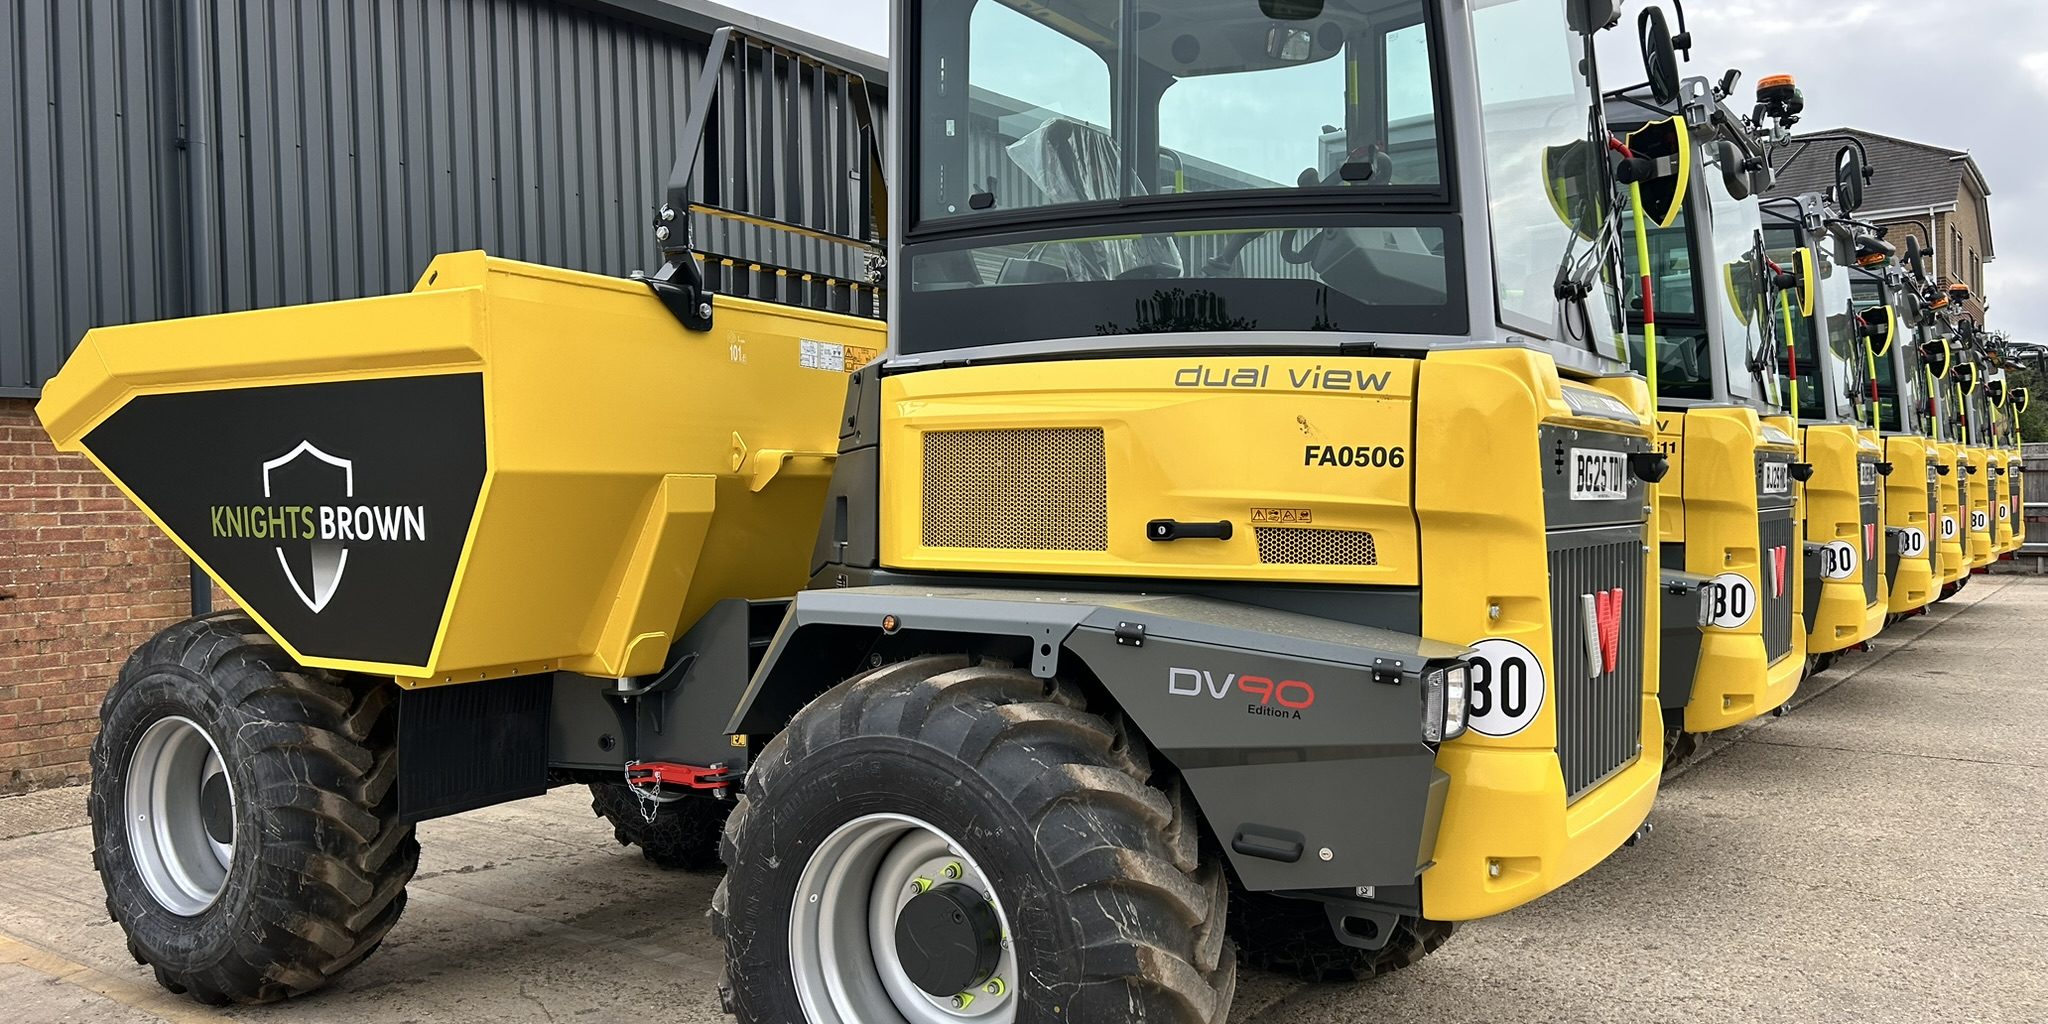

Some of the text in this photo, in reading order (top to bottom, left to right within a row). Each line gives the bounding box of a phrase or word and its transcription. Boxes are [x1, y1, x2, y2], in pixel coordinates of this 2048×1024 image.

[1174, 364, 1392, 392] dual view
[1304, 445, 1405, 468] FA0506
[1577, 455, 1607, 492] BG25
[210, 505, 426, 542] KNIGHTS BROWN
[1168, 667, 1316, 709] DV90
[1470, 656, 1527, 718] 30
[1247, 704, 1302, 720] Edition A
